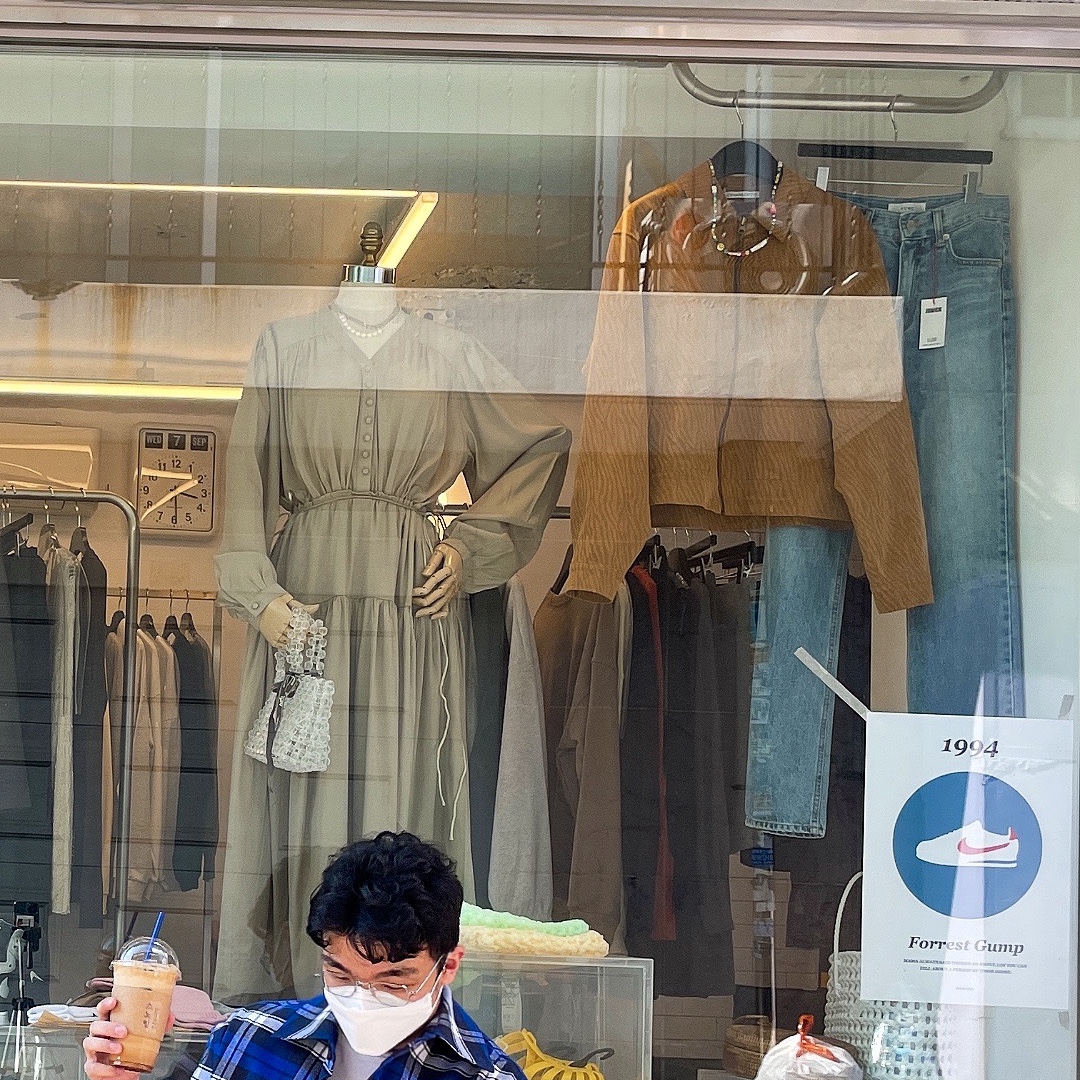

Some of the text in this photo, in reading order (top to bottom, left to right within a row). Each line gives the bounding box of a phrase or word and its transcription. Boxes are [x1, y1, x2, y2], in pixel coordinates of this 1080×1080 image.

[146, 435, 207, 447] WED 7 SEP
[171, 459, 182, 469] 12
[188, 464, 193, 473] 1
[197, 474, 204, 484] 2
[143, 485, 150, 495] 9
[201, 489, 208, 498] 3
[146, 500, 153, 509] 8
[196, 503, 203, 513] 4
[157, 511, 164, 521] 7
[171, 515, 178, 525] 6
[185, 512, 192, 522] 5
[941, 738, 1000, 758] 1994
[907, 935, 1024, 956] Forrest Gump
